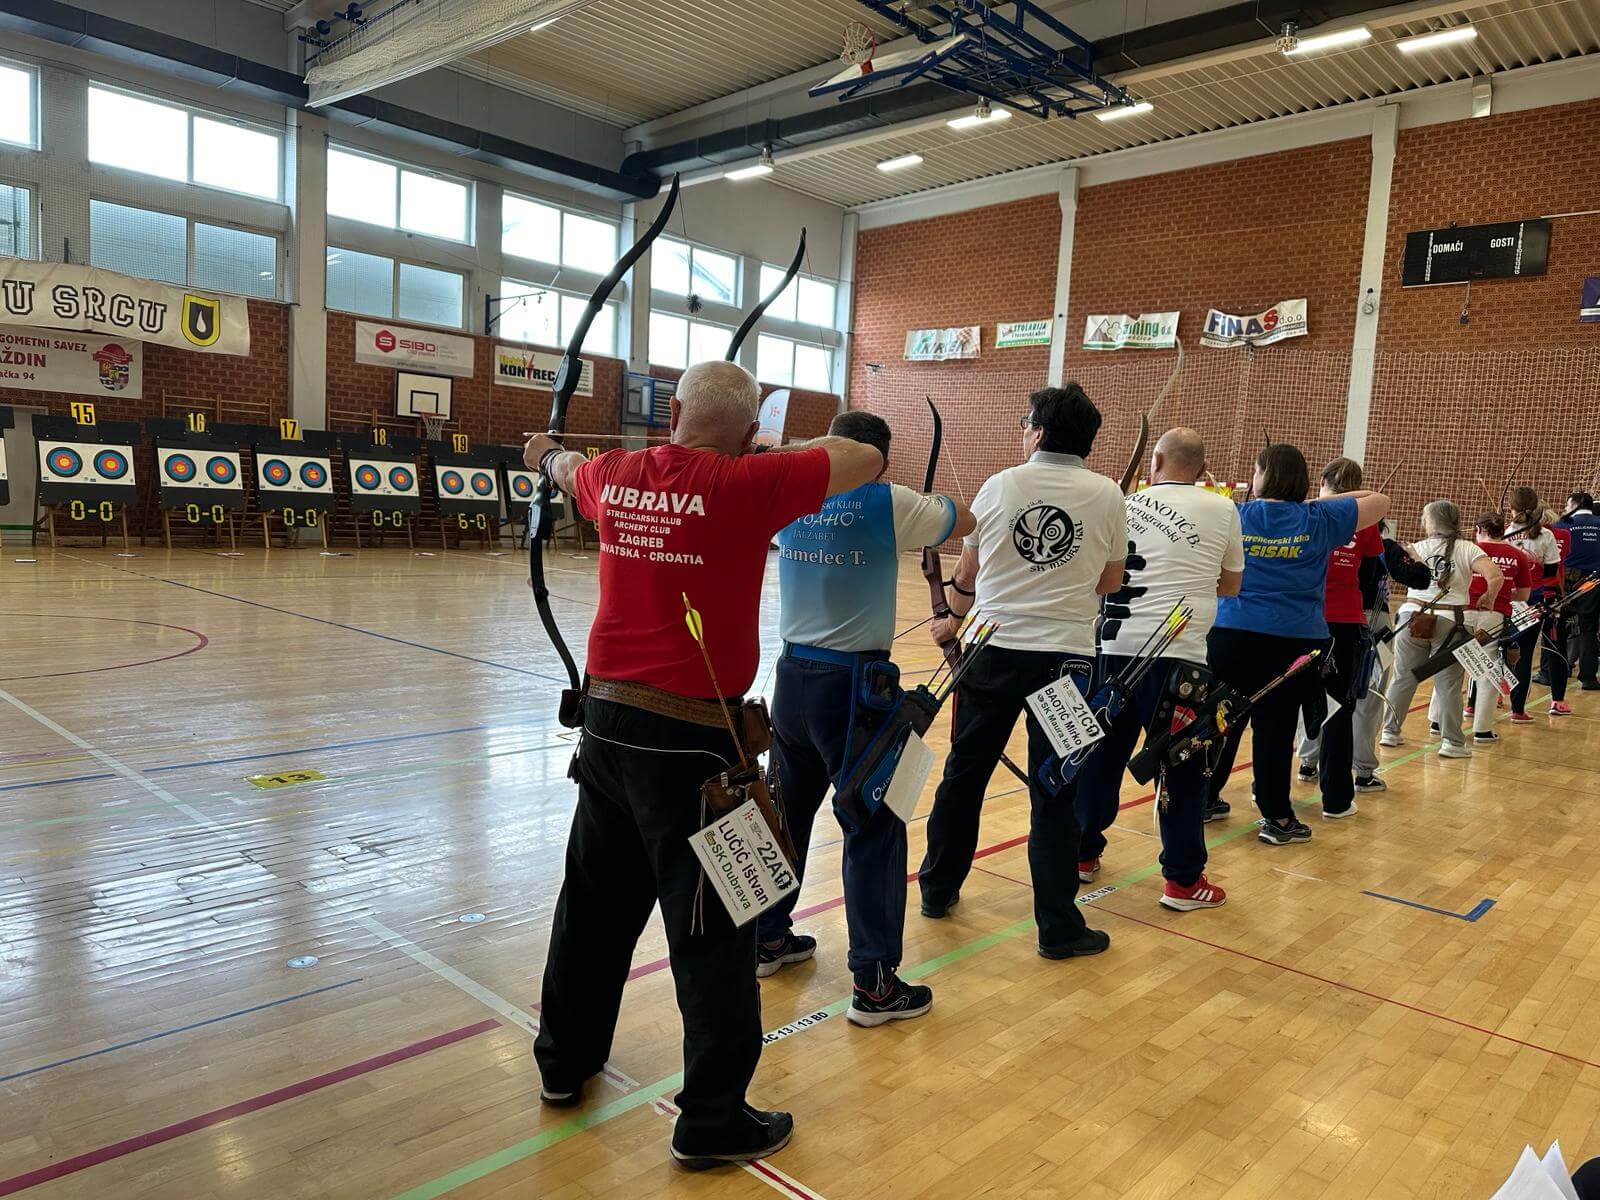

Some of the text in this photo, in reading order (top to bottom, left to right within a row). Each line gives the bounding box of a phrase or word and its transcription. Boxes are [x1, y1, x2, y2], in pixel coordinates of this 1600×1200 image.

[1433, 241, 1463, 254] DOMAĆI
[1490, 237, 1514, 249] GOSTI
[2, 279, 167, 334] U SRCU
[54, 340, 88, 352] SAVEZ
[399, 339, 435, 352] SIBO
[0, 345, 47, 368] ŽDIN
[23, 372, 35, 380] 94
[74, 404, 94, 424] 15
[188, 413, 206, 433] 16
[282, 421, 298, 439] 17
[373, 428, 387, 446] 18
[454, 435, 467, 453] 19
[836, 501, 862, 510] KLUB
[614, 521, 671, 535] ARCHERY CLUB
[660, 517, 682, 526] KLUB
[618, 533, 664, 548] ZAGREB
[1186, 534, 1200, 548] B.
[650, 552, 704, 565] CROATIA
[850, 550, 866, 565] T.
[1489, 556, 1518, 567] RAVA
[1041, 702, 1052, 715] SK
[1048, 714, 1065, 739] Maura
[1044, 687, 1082, 746] BAOTIĆ Mirko
[718, 820, 769, 906] LUČIĆ Ištvan
[711, 843, 751, 910] SK Dubrava
[762, 1033, 779, 1045] AC
[778, 1027, 794, 1036] 13
[797, 1018, 813, 1027] 13
[811, 1011, 829, 1021] BD
